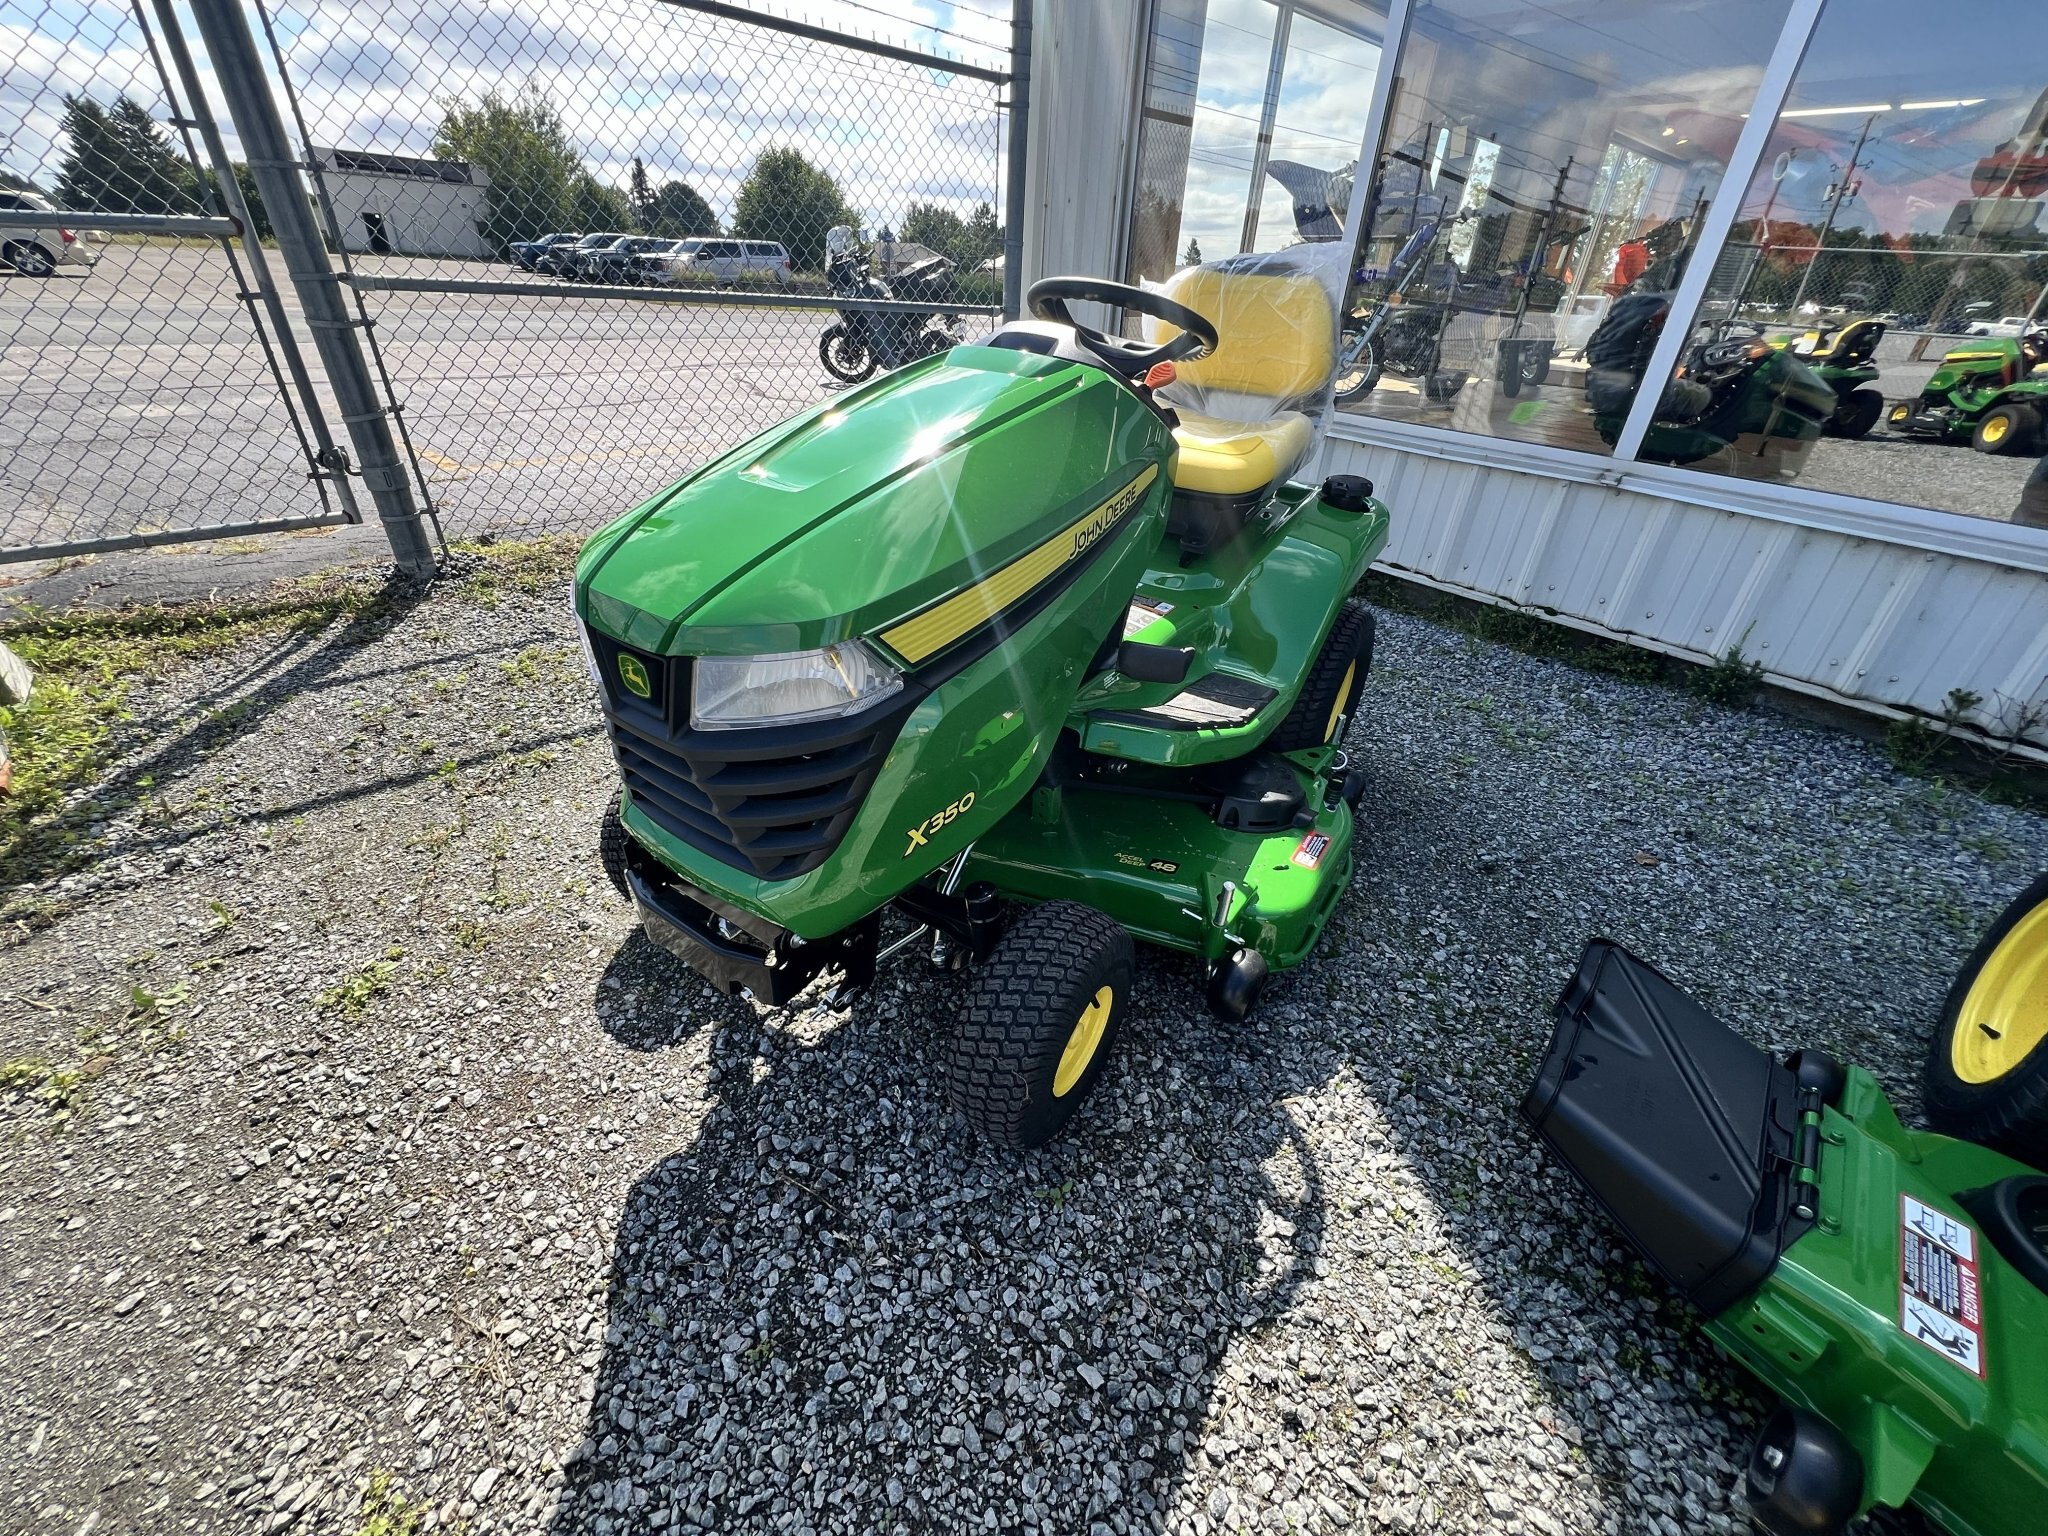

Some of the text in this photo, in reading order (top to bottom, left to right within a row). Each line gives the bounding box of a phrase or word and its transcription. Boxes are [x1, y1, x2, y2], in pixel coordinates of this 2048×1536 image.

[1069, 484, 1138, 559] JOHN DEERE
[903, 791, 976, 858] X350
[1113, 852, 1145, 862] ACCEL
[1119, 858, 1146, 867] DEEP
[1150, 861, 1177, 872] 48
[1962, 1275, 1979, 1325] DANGER
